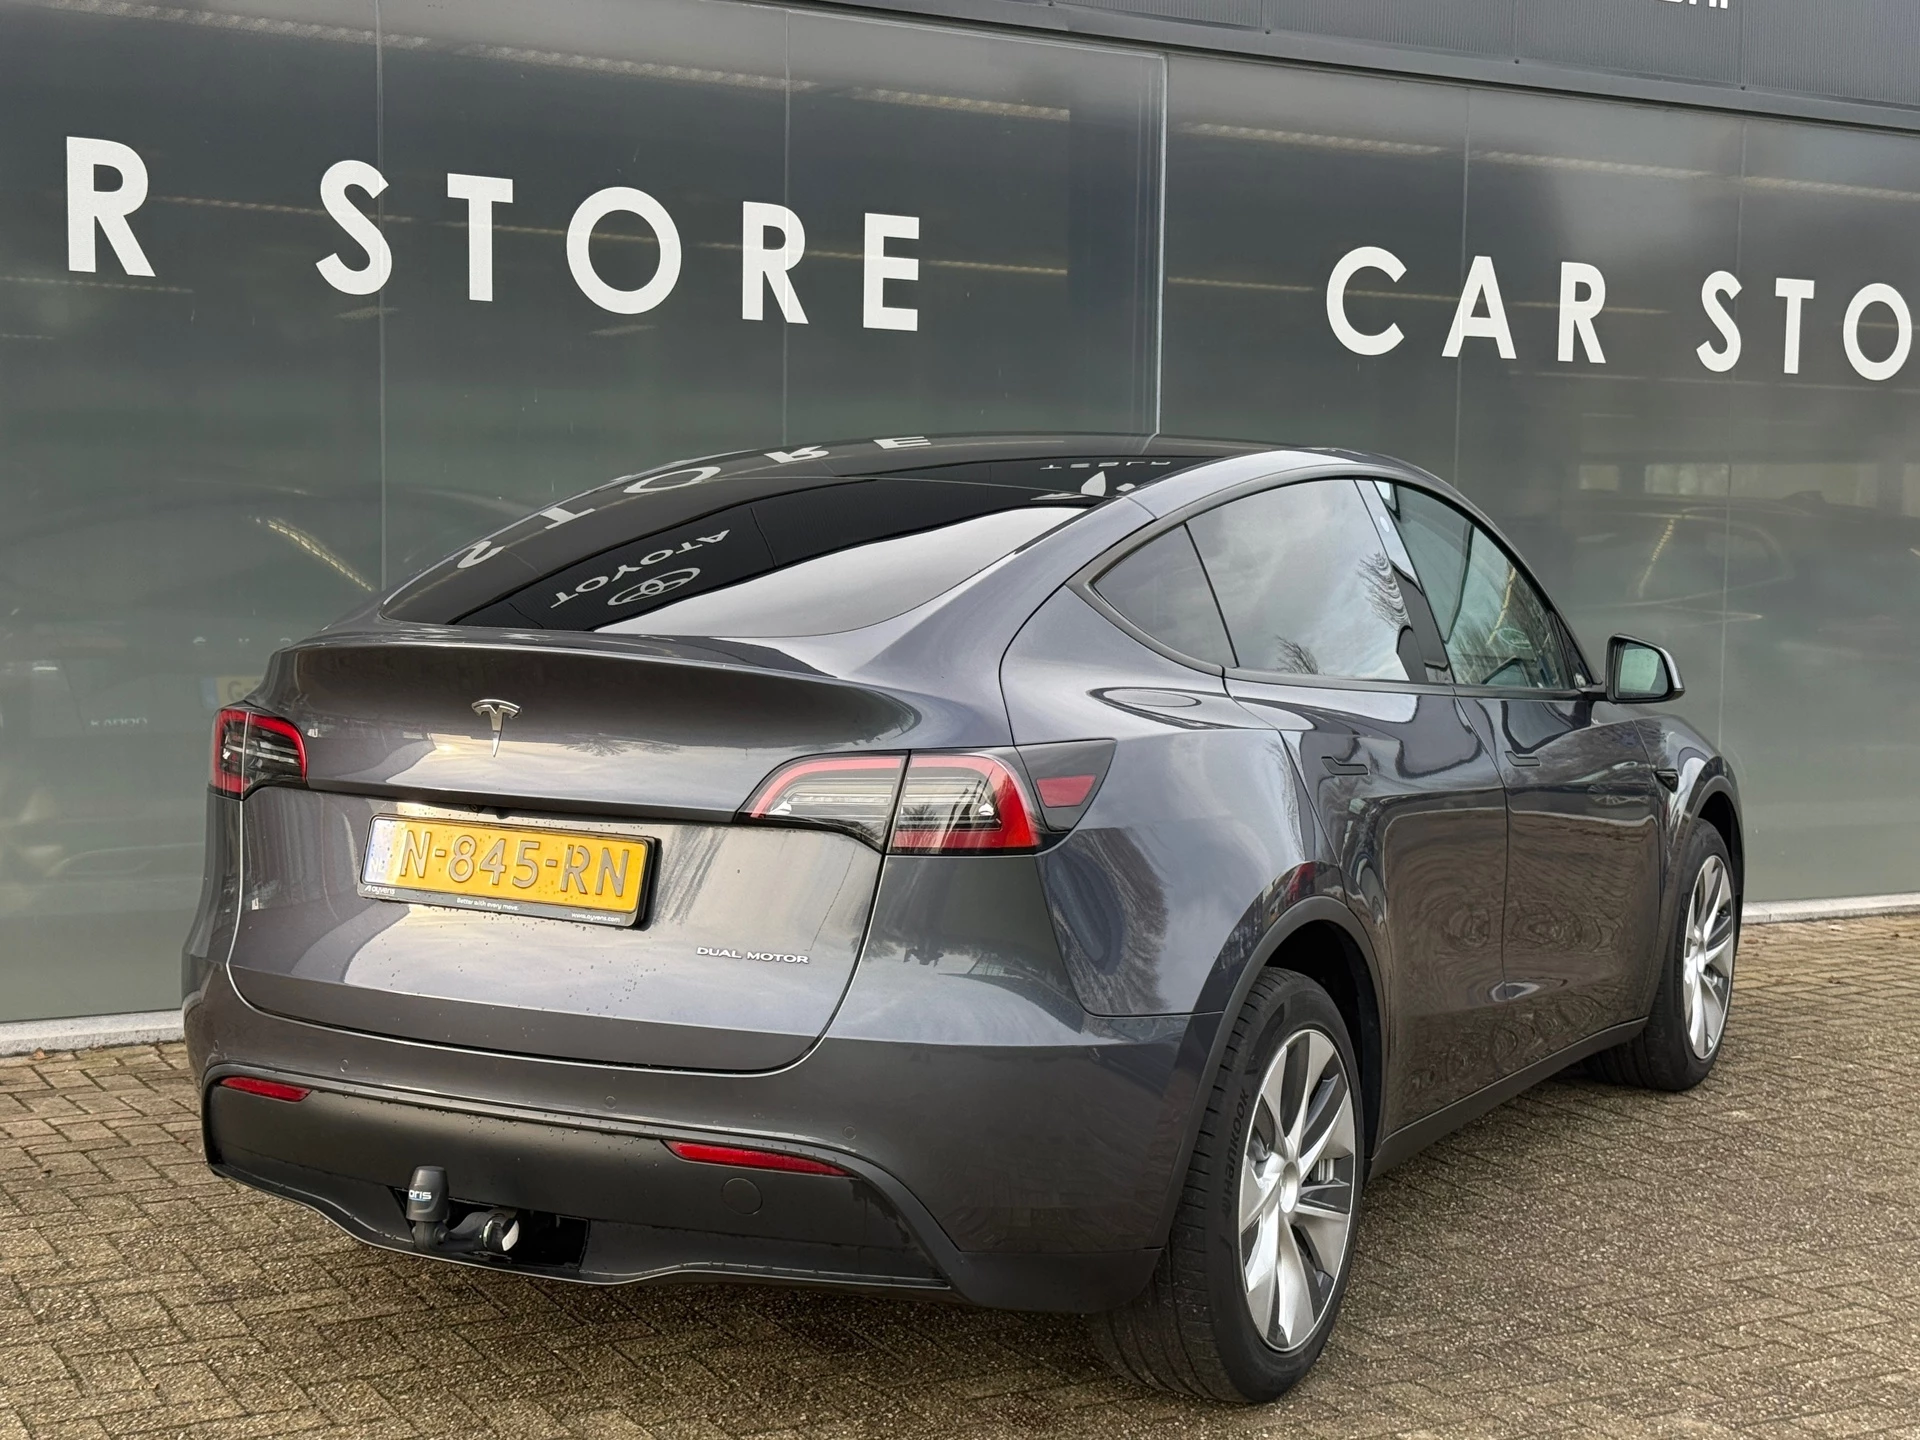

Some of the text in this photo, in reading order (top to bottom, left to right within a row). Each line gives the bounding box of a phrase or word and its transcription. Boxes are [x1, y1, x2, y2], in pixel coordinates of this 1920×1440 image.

[66, 136, 920, 332] R STORE
[1326, 246, 1912, 381] CAR STO
[400, 830, 630, 897] N-845-RN
[696, 947, 809, 964] DUAL MOTOR
